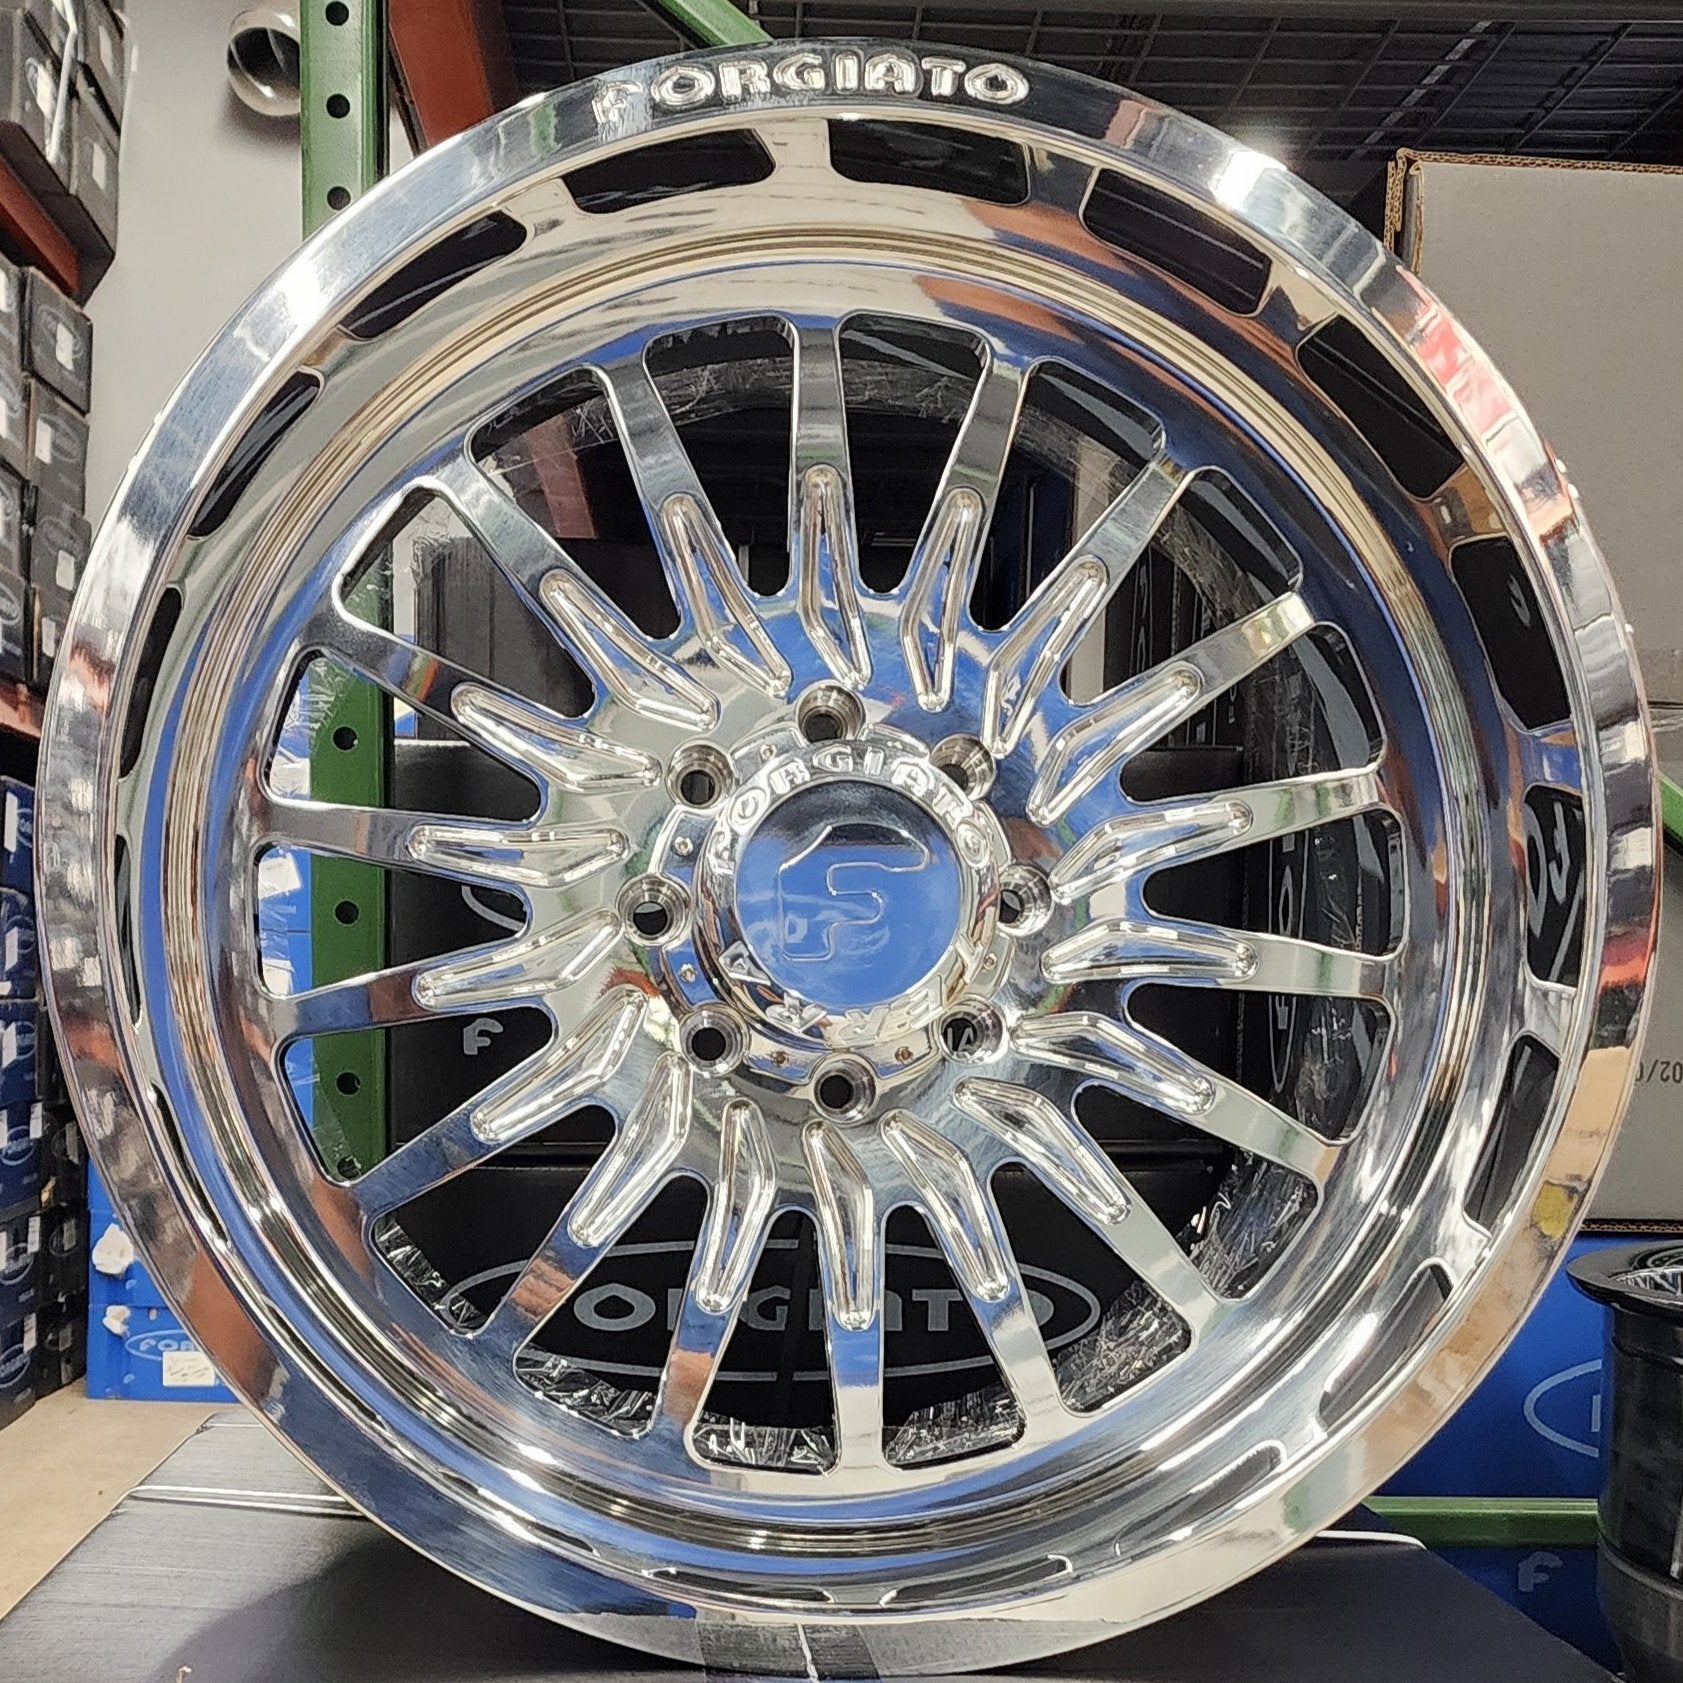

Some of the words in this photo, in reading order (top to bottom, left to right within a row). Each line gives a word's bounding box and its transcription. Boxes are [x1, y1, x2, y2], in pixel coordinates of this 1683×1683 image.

[591, 52, 1030, 127] FORGIATO
[706, 744, 993, 874] FORGIATO
[719, 934, 981, 1049] TERRA
